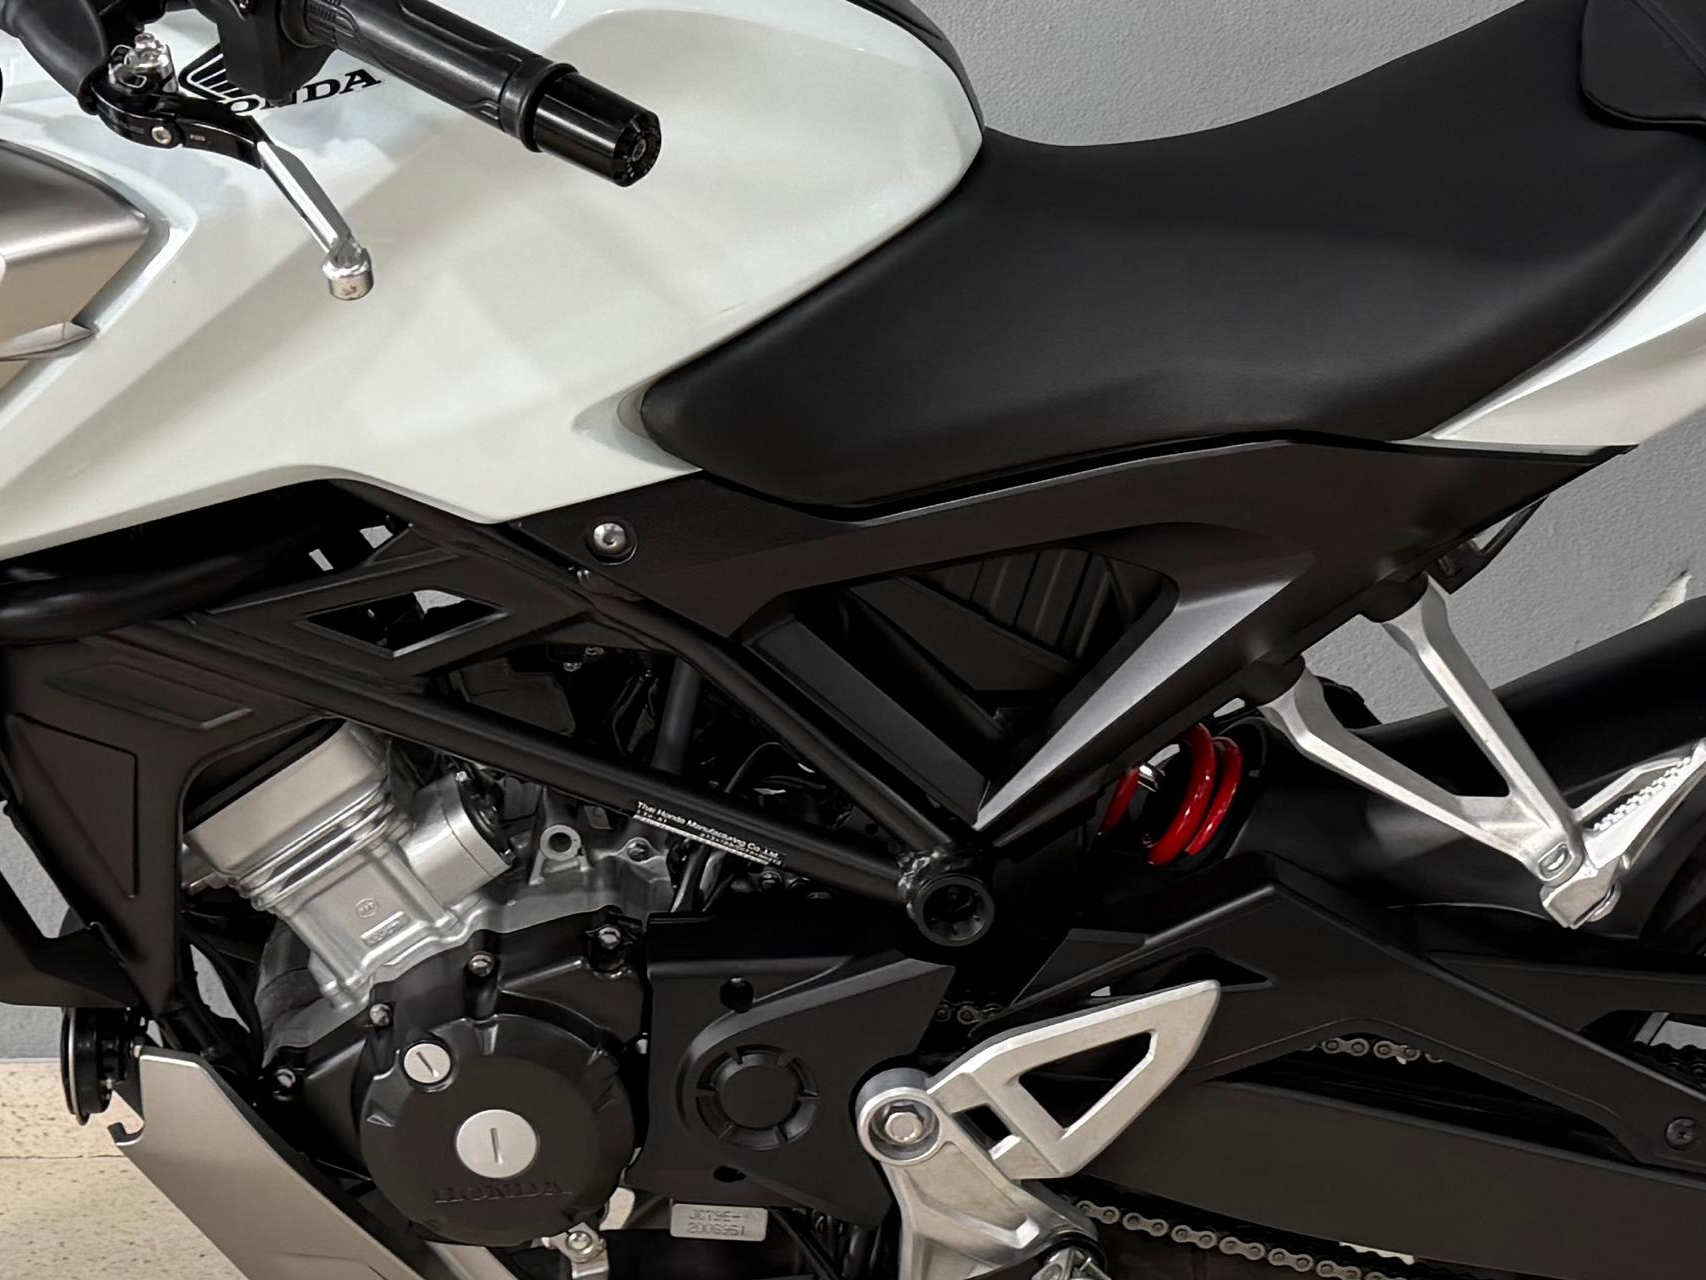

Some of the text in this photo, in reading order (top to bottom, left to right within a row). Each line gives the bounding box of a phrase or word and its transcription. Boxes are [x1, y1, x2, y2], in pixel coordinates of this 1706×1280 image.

[227, 68, 382, 115] ODA
[637, 800, 656, 815] Thai
[656, 808, 686, 824] Honda
[686, 819, 747, 848] Manufacturing
